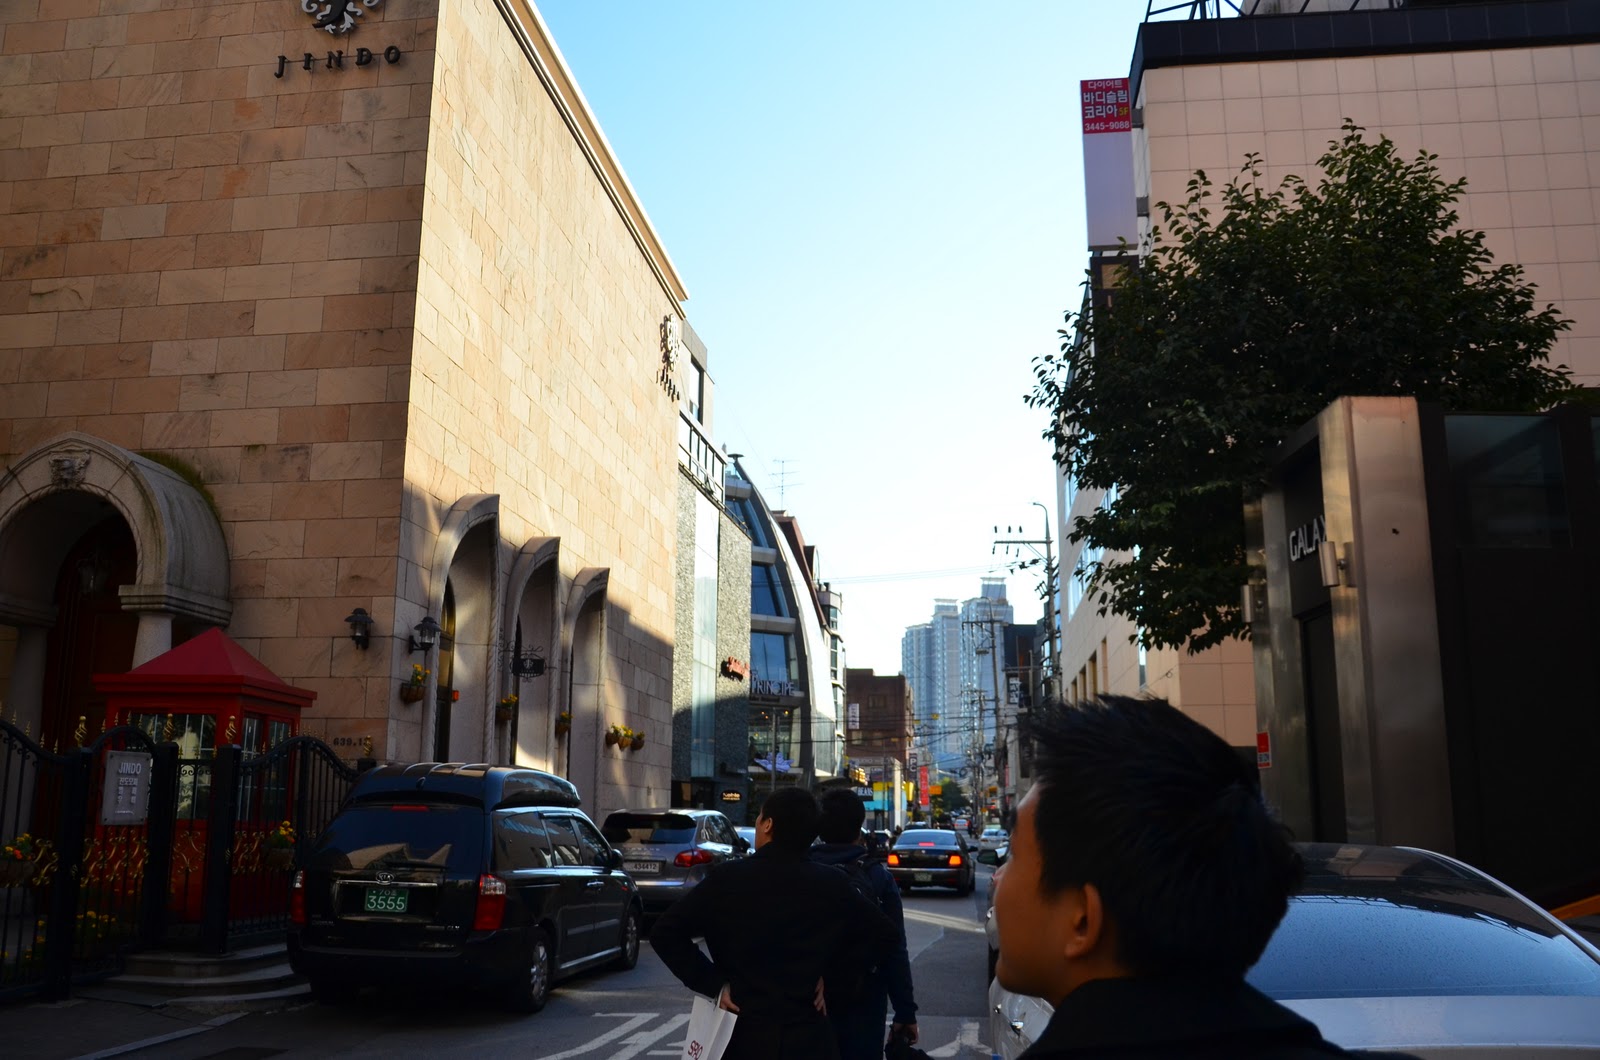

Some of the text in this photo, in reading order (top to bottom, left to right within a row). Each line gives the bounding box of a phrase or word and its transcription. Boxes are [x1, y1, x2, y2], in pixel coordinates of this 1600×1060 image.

[274, 45, 401, 79] JINDO
[1088, 80, 1122, 90] 다이어트
[1083, 90, 1128, 104] 바디슬림
[1085, 105, 1117, 118] 코리아
[1085, 121, 1130, 131] 3445-9088
[751, 674, 795, 697] PRINCIPE
[119, 762, 142, 775] JINDO
[367, 895, 405, 910] 3555
